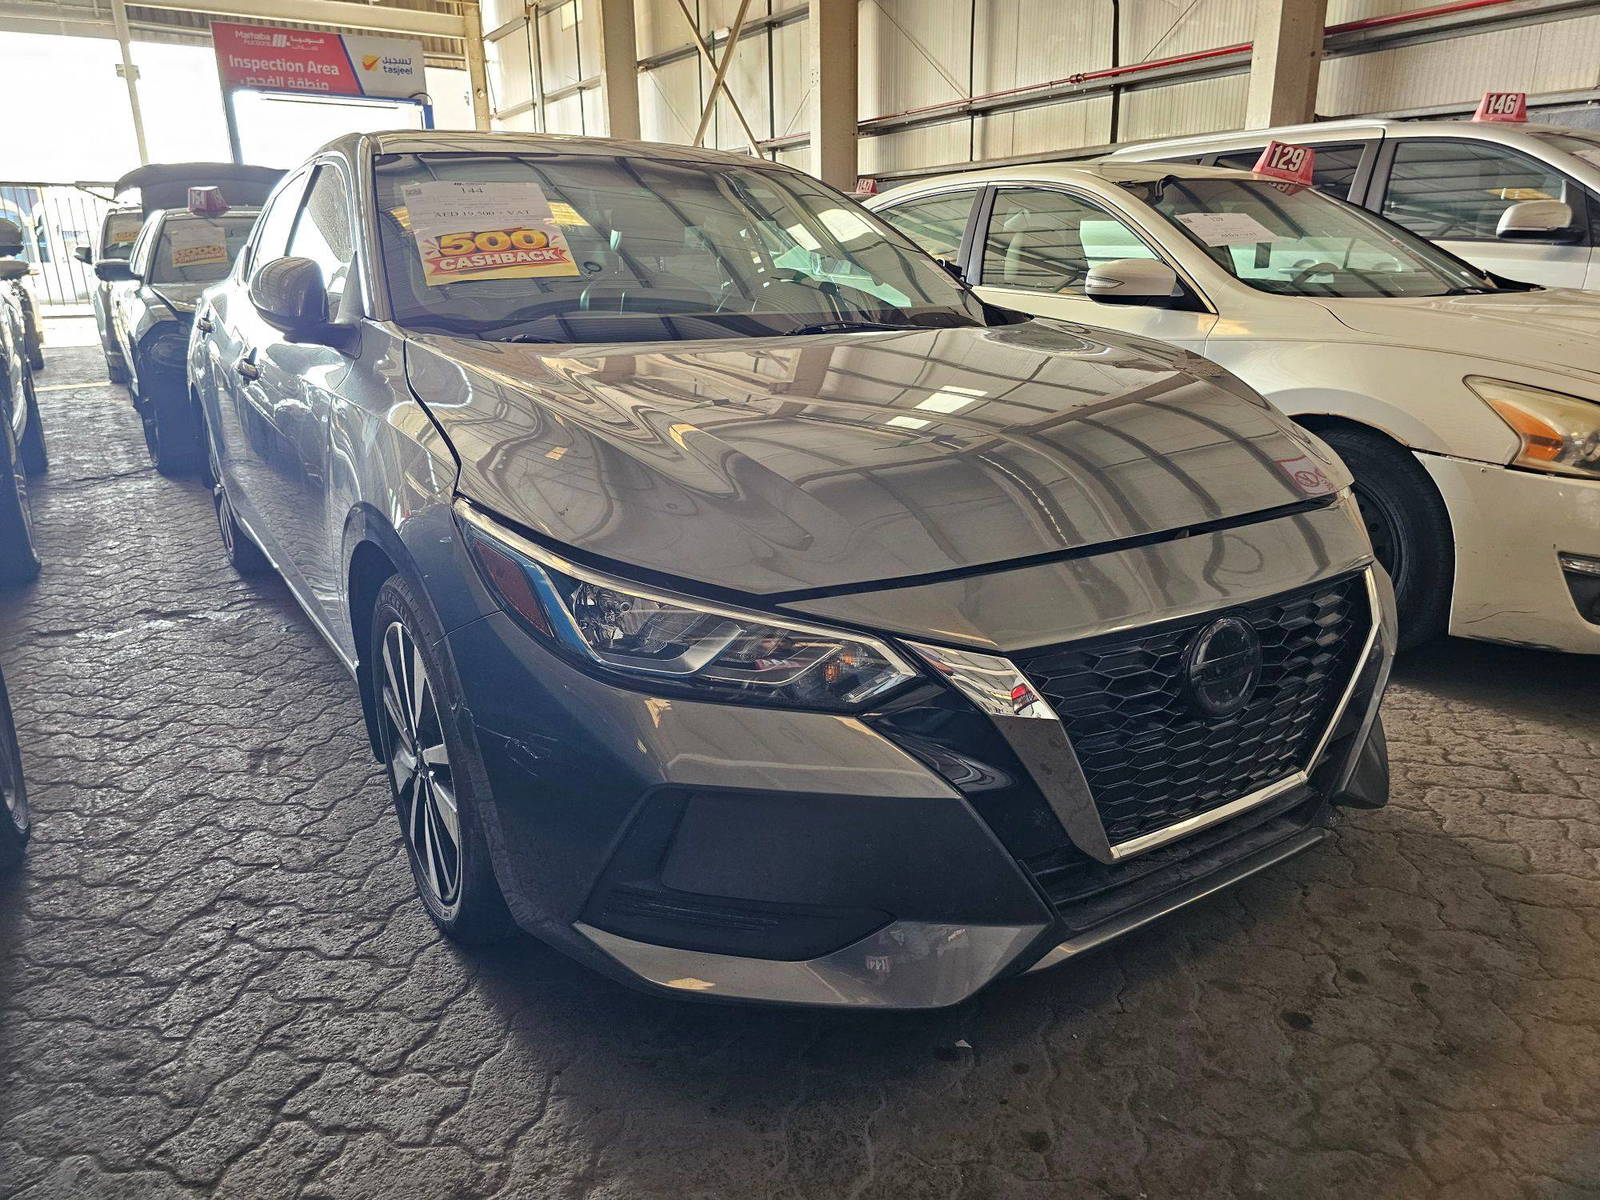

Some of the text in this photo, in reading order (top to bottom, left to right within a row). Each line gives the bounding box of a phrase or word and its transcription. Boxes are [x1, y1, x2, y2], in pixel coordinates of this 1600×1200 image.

[229, 54, 340, 75] Inspection Area
[383, 65, 413, 76] tasjeel
[288, 76, 329, 91] منطقة
[1486, 94, 1516, 114] 146
[1268, 145, 1306, 171] 129
[437, 229, 549, 256] 500
[438, 249, 559, 271] CASHBACK
